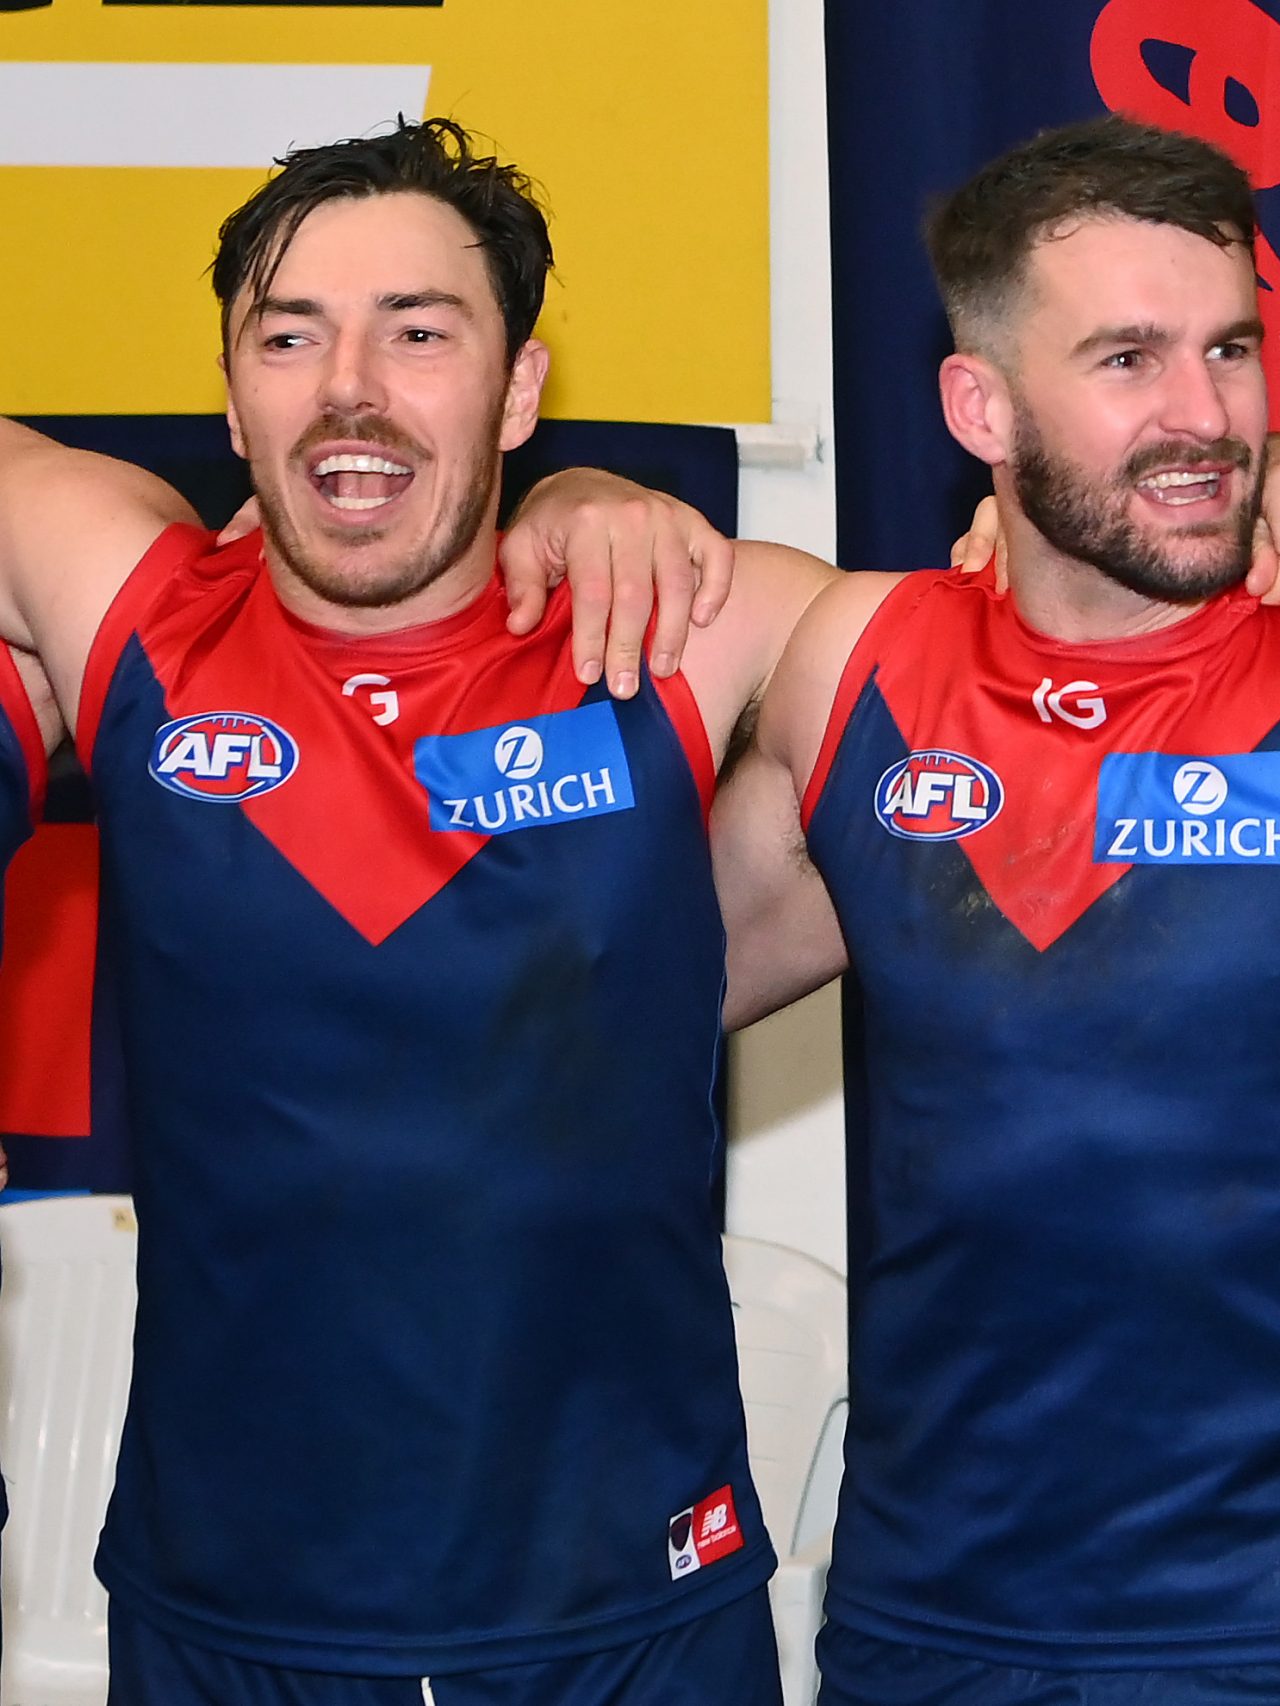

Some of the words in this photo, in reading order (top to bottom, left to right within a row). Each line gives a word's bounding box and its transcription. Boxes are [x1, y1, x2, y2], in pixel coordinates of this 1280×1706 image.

[1032, 677, 1107, 730] IG
[157, 731, 282, 778] AFL
[442, 767, 616, 829] ZURICH
[882, 771, 987, 820] AFL
